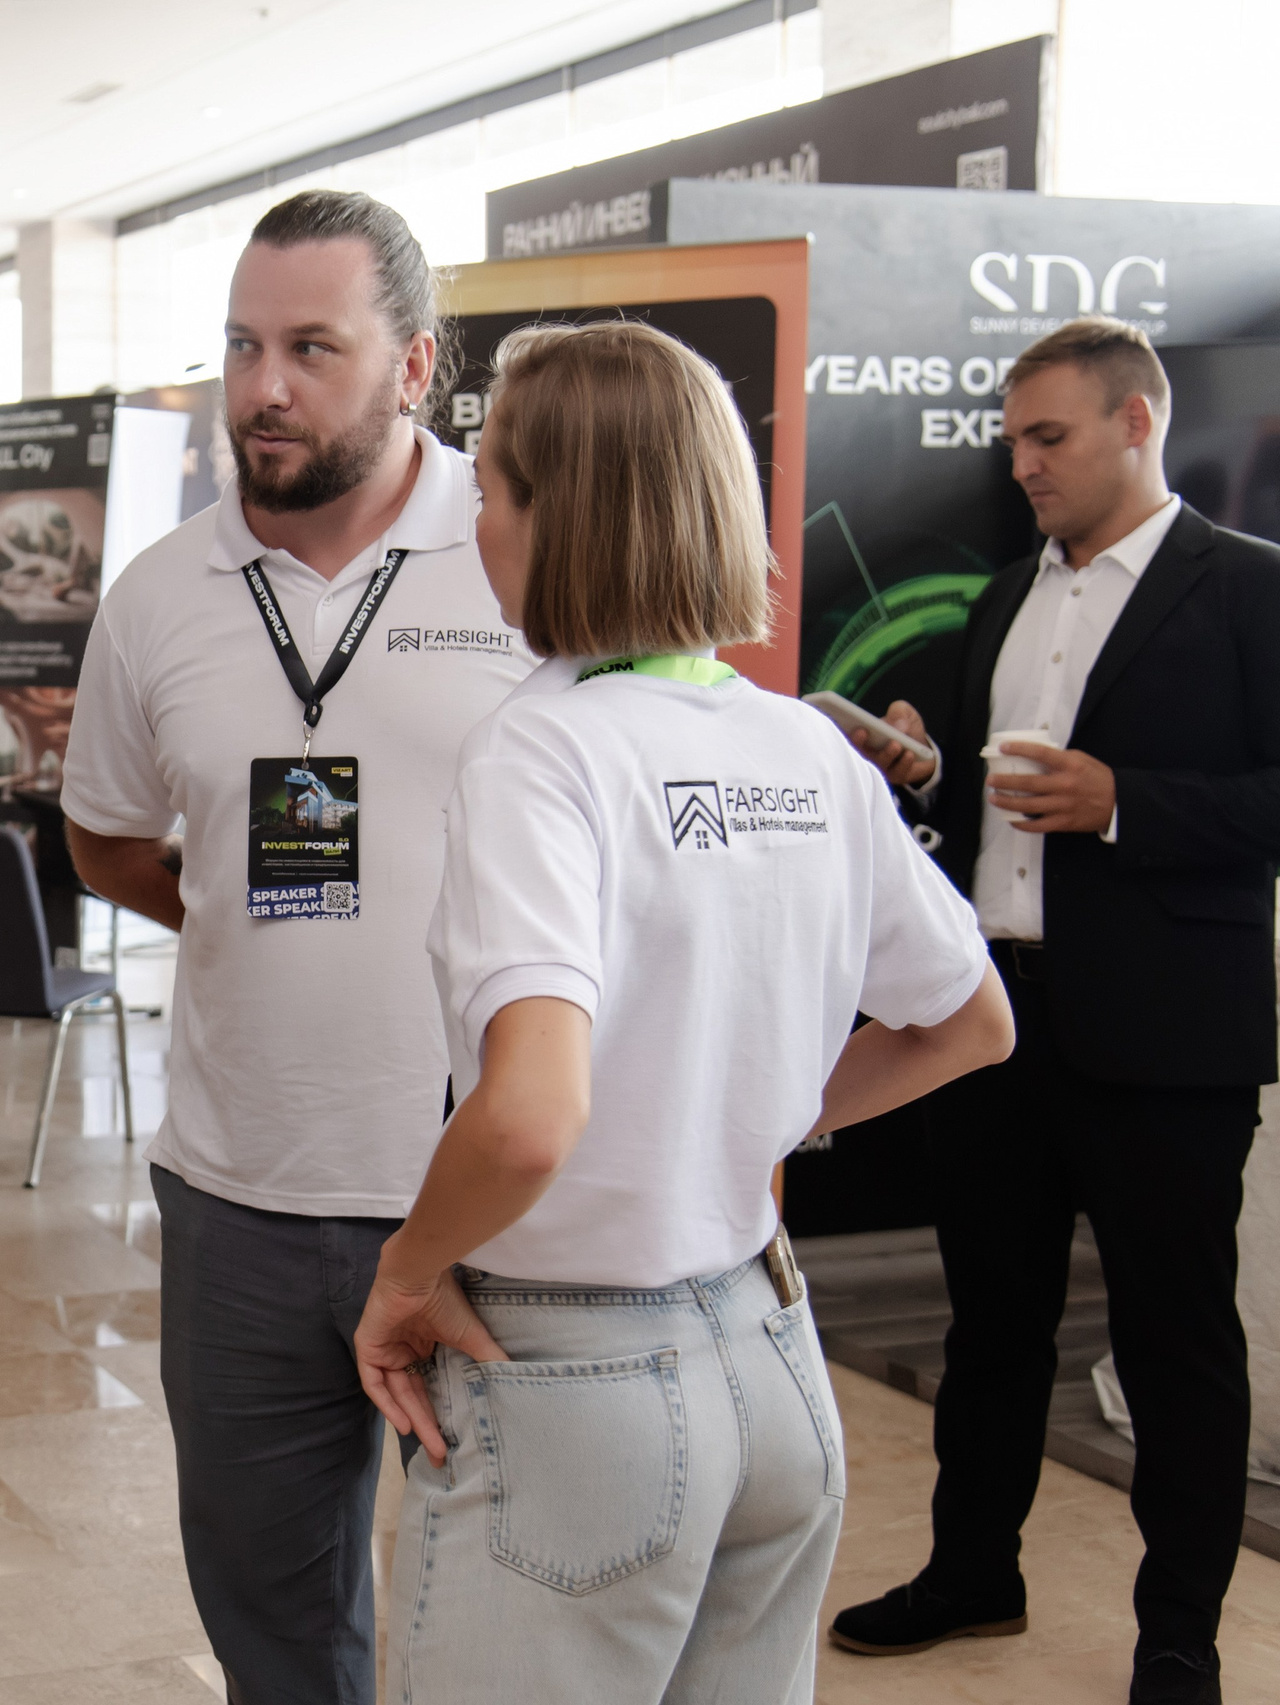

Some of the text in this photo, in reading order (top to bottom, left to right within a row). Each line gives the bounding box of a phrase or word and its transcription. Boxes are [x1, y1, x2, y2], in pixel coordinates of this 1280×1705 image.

[804, 355, 953, 396] YEARS
[424, 629, 513, 648] FARSIGHT
[469, 646, 513, 657] management
[725, 786, 819, 815] FARSIGHT
[749, 817, 757, 832] &
[759, 816, 785, 832] Hotels
[785, 820, 829, 836] management
[253, 887, 317, 903] SPEAKER
